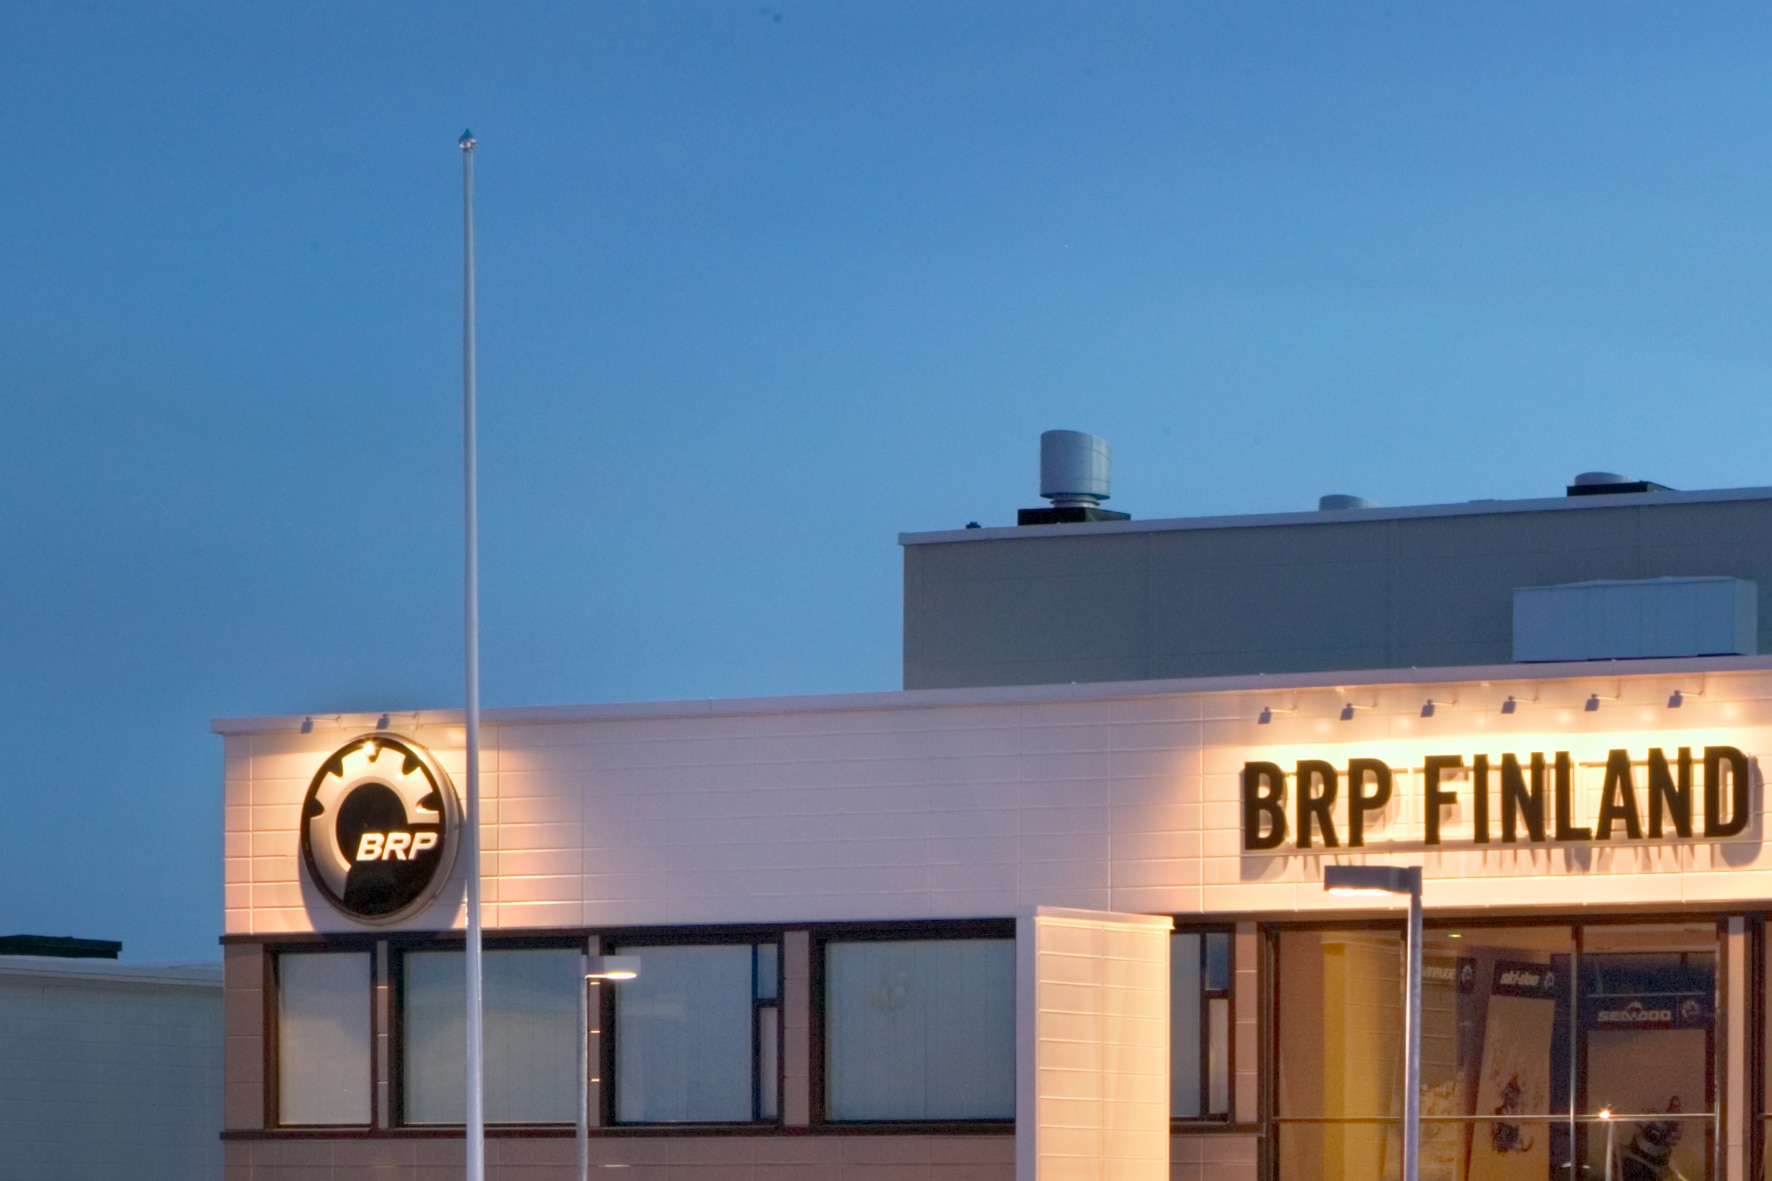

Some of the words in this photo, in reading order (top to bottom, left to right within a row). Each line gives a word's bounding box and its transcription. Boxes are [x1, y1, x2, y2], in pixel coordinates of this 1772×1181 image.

[1244, 757, 1393, 850] BRP
[1424, 745, 1750, 846] FINLAND
[356, 832, 438, 861] BRP
